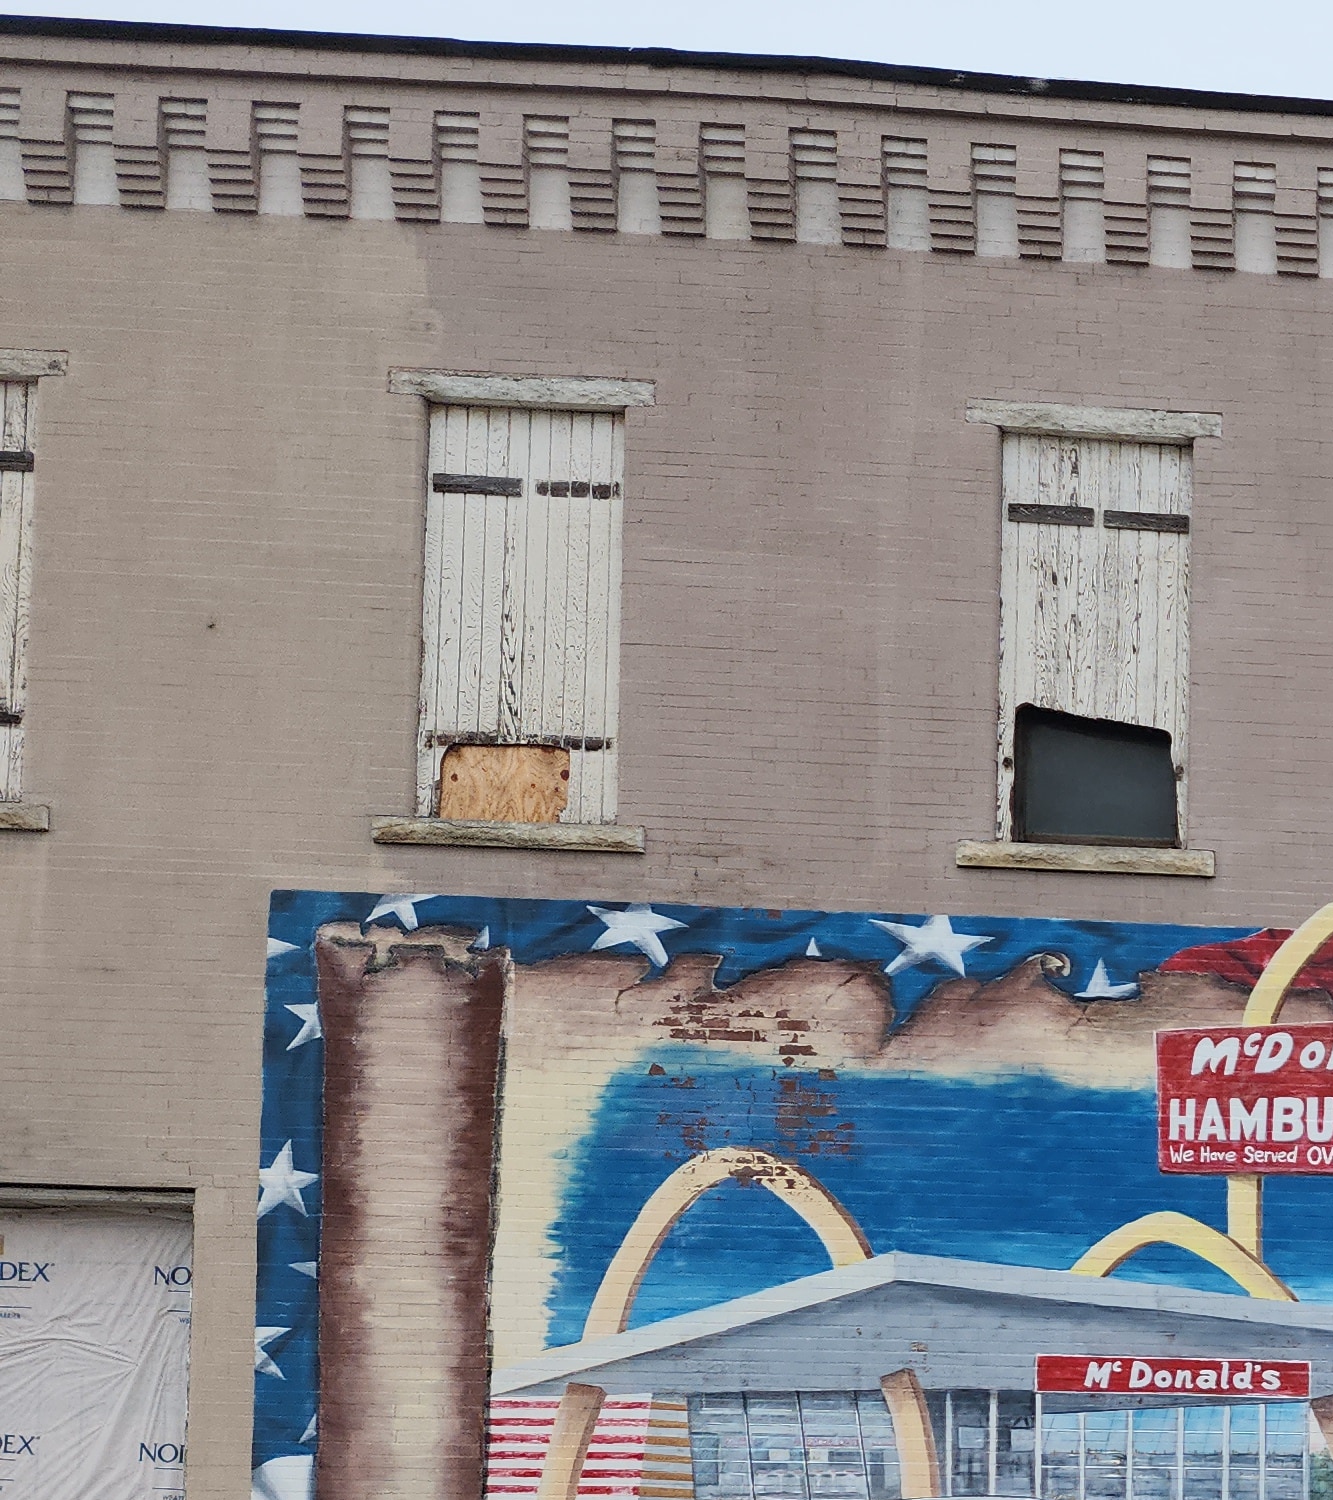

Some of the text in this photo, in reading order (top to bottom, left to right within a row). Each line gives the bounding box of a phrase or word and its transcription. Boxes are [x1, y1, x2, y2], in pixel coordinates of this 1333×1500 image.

[1169, 1144, 1195, 1164] We
[1200, 1145, 1235, 1164] Have
[1242, 1145, 1298, 1165] Served
